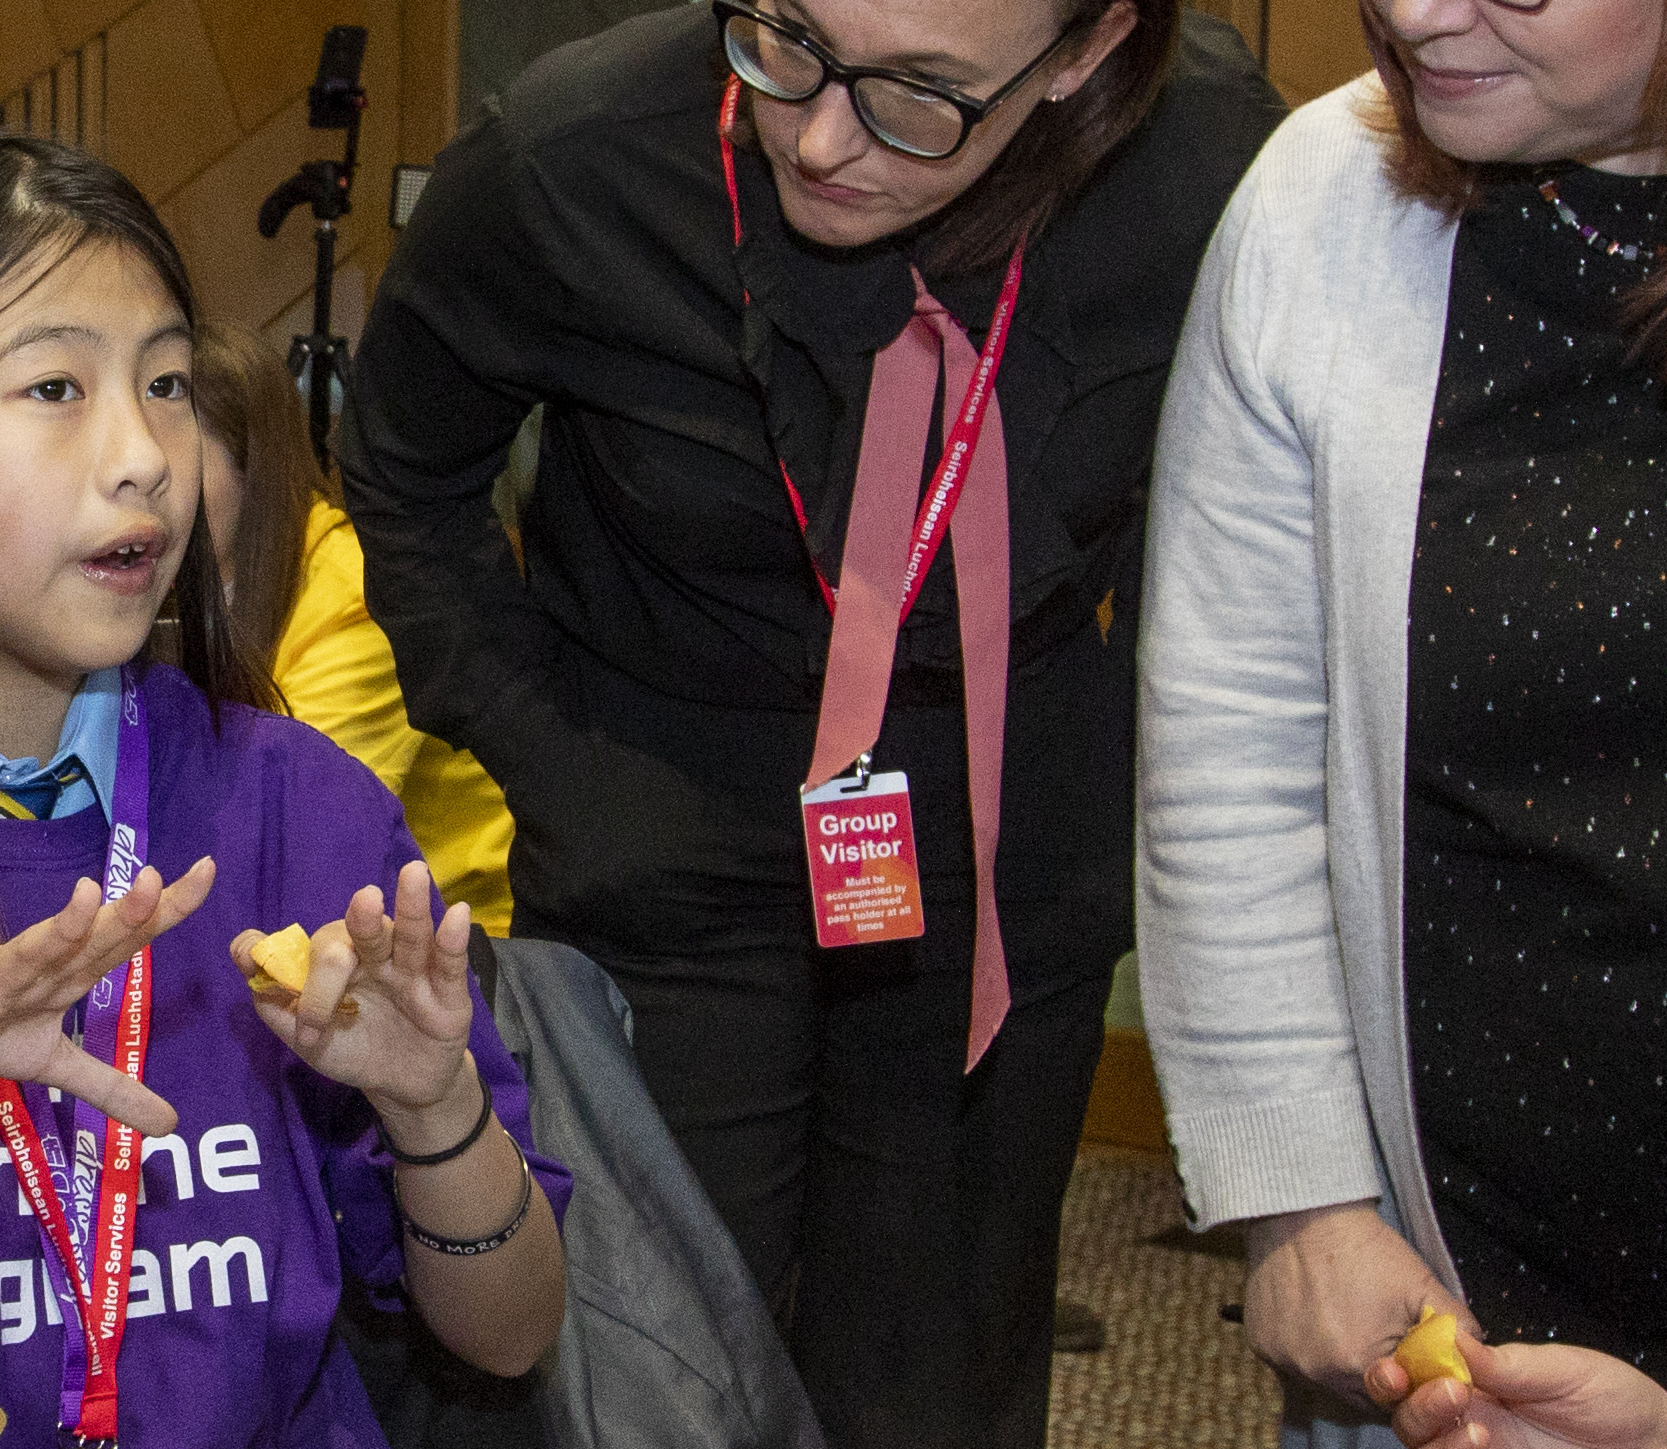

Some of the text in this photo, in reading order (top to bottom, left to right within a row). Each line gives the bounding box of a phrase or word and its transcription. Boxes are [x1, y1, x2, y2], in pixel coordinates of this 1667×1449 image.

[966, 357, 995, 424] Services
[819, 812, 897, 835] Group
[820, 839, 902, 864] Visitor
[845, 875, 886, 887] Must be
[826, 885, 907, 901] accompanied by
[850, 895, 902, 910] authorised
[827, 915, 851, 926] pass
[853, 910, 884, 921] holder
[857, 921, 884, 932] times
[100, 1192, 127, 1340] Visitor Services
